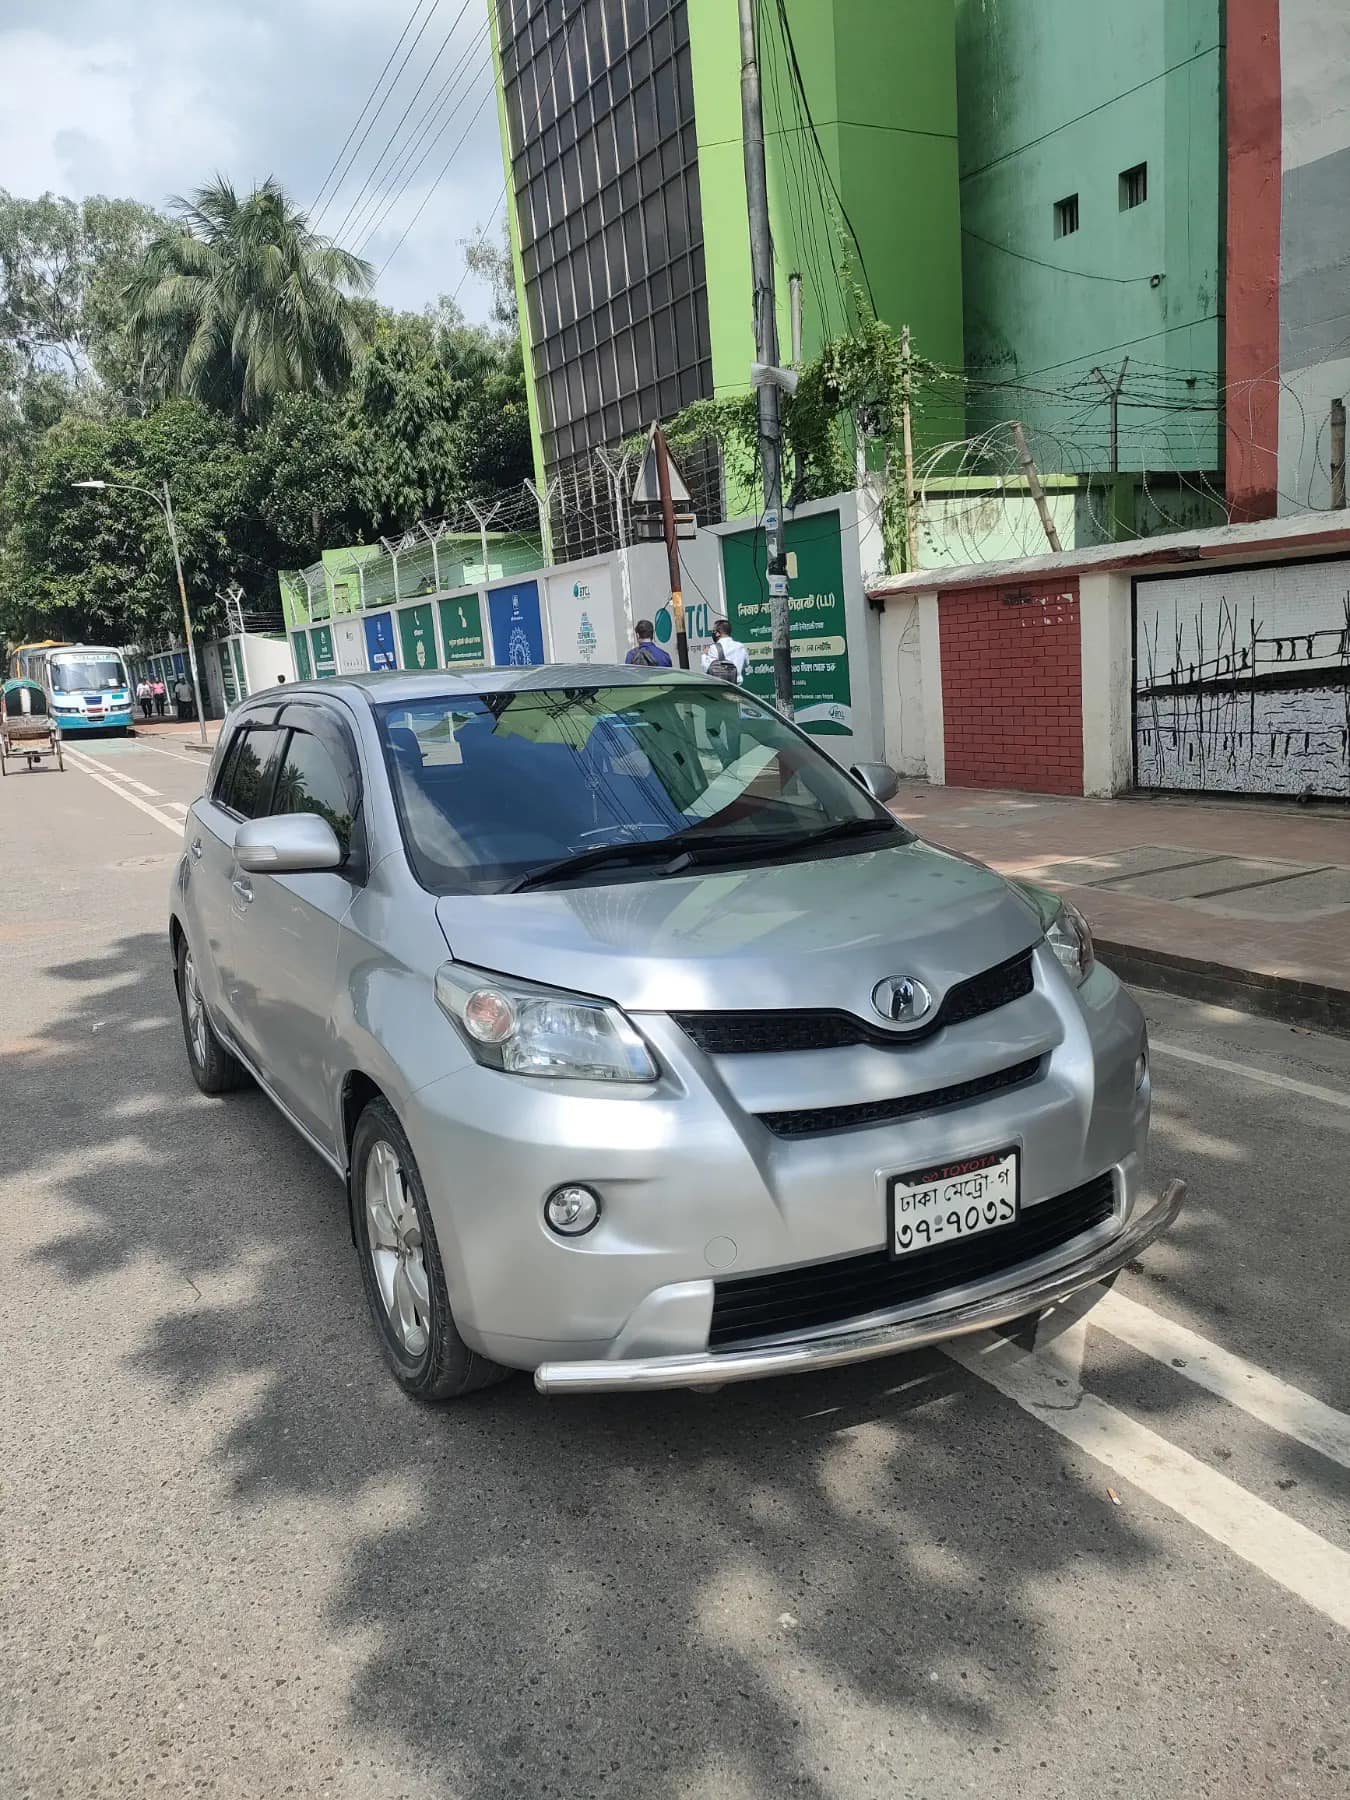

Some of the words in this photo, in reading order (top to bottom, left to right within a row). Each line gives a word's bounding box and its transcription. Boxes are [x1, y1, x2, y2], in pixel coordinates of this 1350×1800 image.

[685, 604, 713, 639] TCL
[941, 1155, 998, 1179] TOYOTA
[901, 1188, 938, 1212] ঢাকা
[896, 1198, 1015, 1249] ৩৭-৭০৩১
